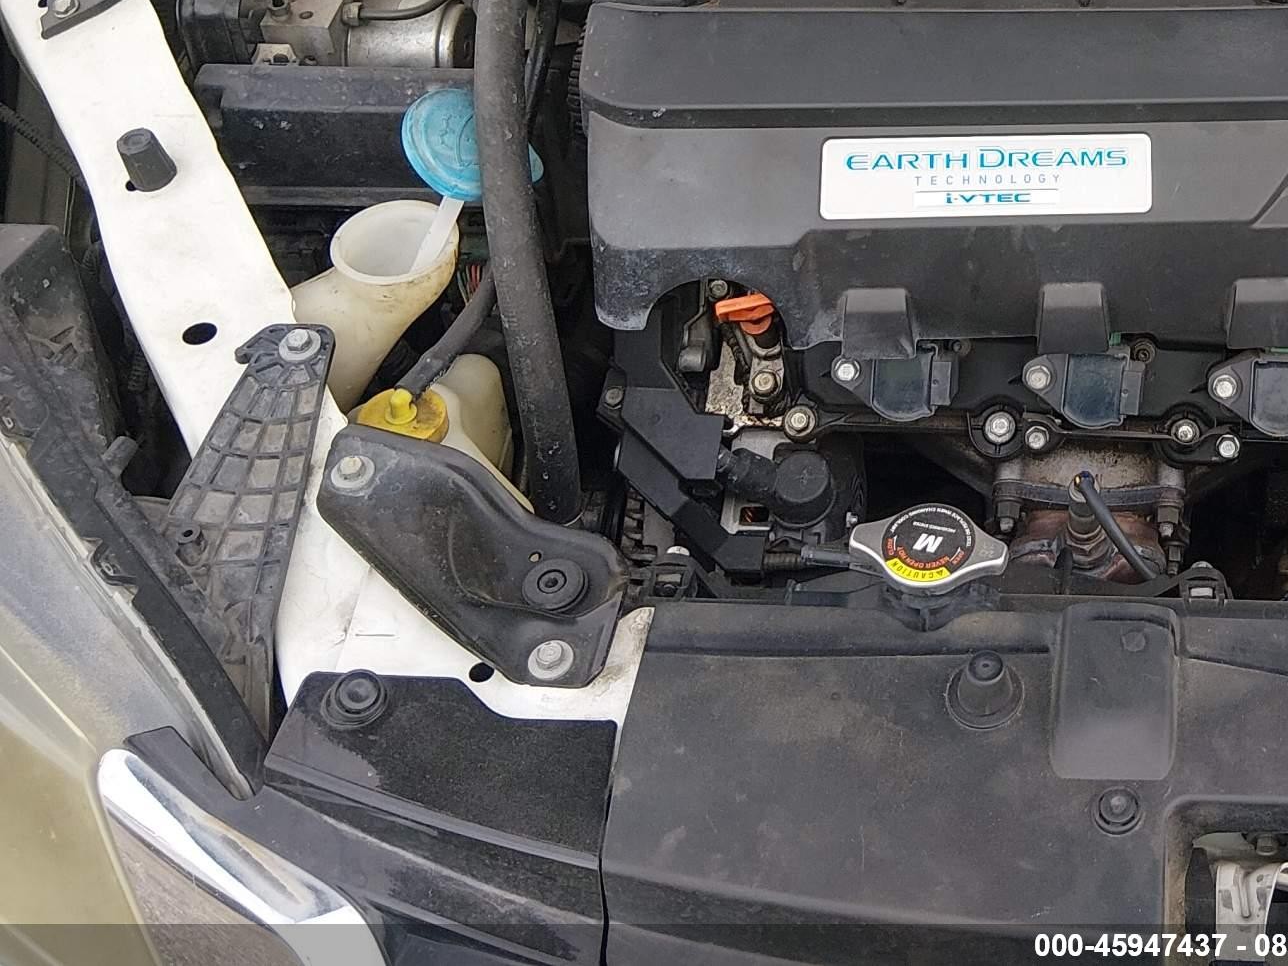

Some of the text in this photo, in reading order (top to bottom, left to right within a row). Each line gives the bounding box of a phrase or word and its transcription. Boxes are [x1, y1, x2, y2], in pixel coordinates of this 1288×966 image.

[845, 145, 1128, 171] EARTH DREAMS
[914, 174, 1062, 187] TECHNOLOGY
[912, 533, 943, 553] M
[891, 561, 934, 578] CAUTION
[925, 556, 949, 568] NEVER
